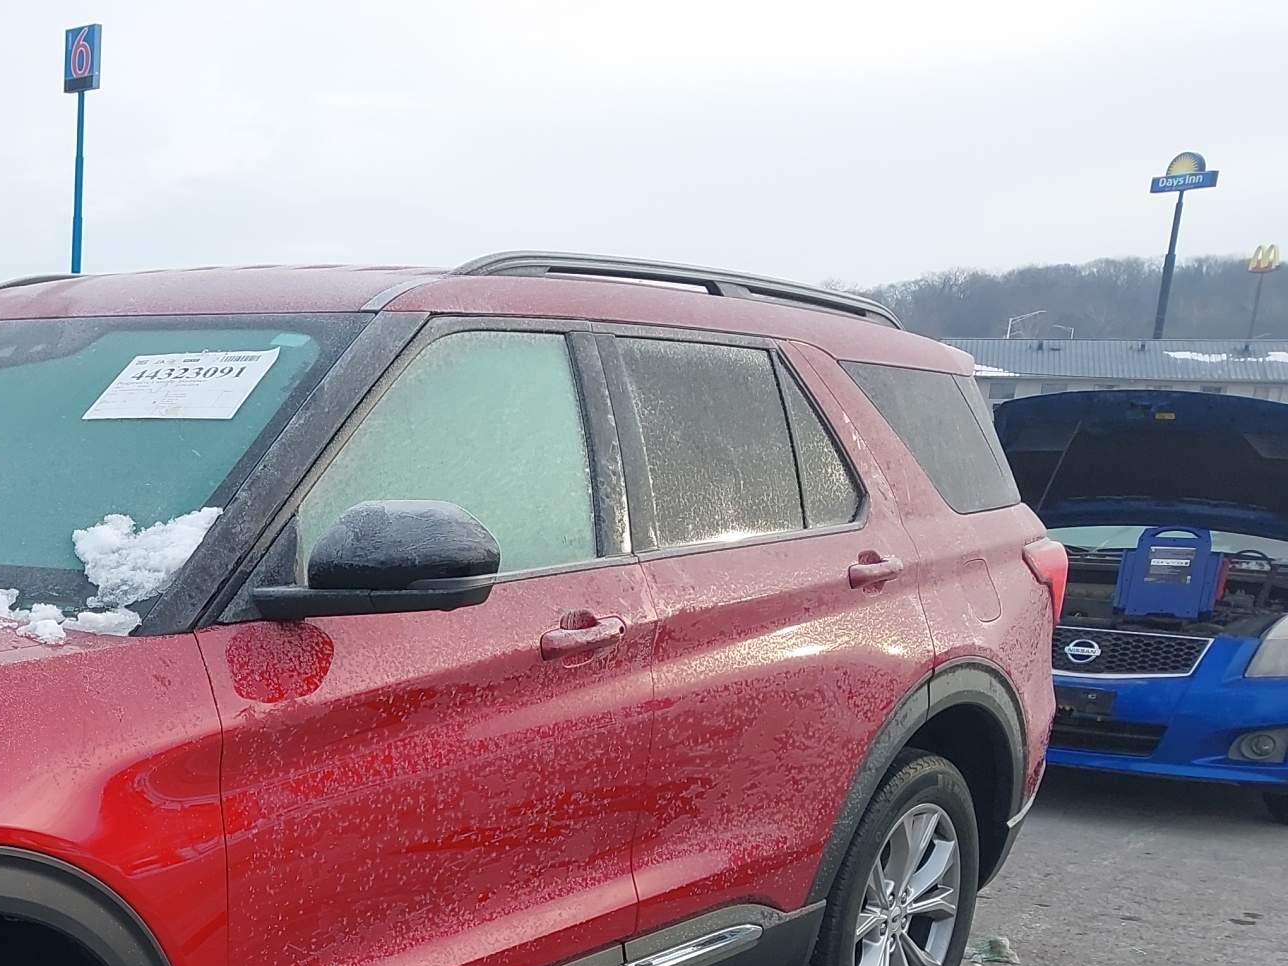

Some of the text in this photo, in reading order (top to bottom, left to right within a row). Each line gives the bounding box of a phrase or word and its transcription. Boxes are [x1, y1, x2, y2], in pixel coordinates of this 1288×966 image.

[71, 27, 91, 78] 6
[1159, 174, 1203, 187] Days Inn
[130, 366, 247, 381] 44323091
[1067, 646, 1097, 655] NISSAN
